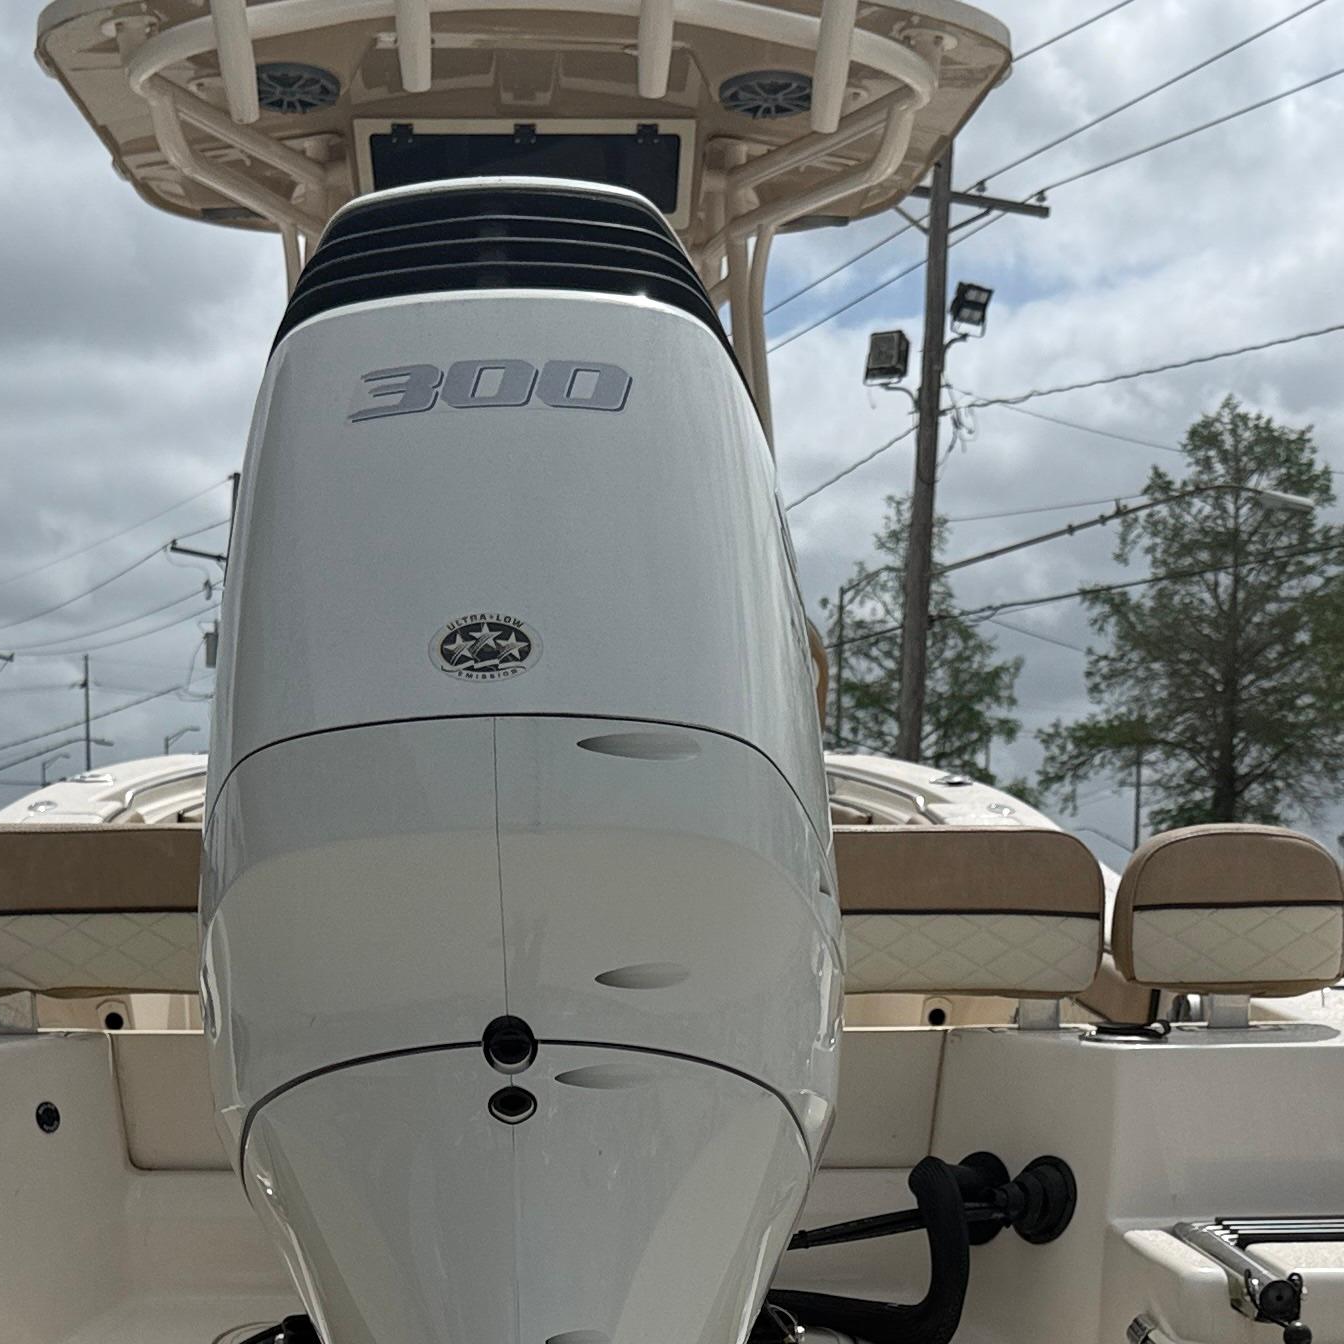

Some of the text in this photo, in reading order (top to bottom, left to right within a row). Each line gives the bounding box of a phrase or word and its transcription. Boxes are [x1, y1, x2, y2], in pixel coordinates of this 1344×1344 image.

[346, 358, 633, 424] 300
[446, 613, 525, 631] ULTRA LOW
